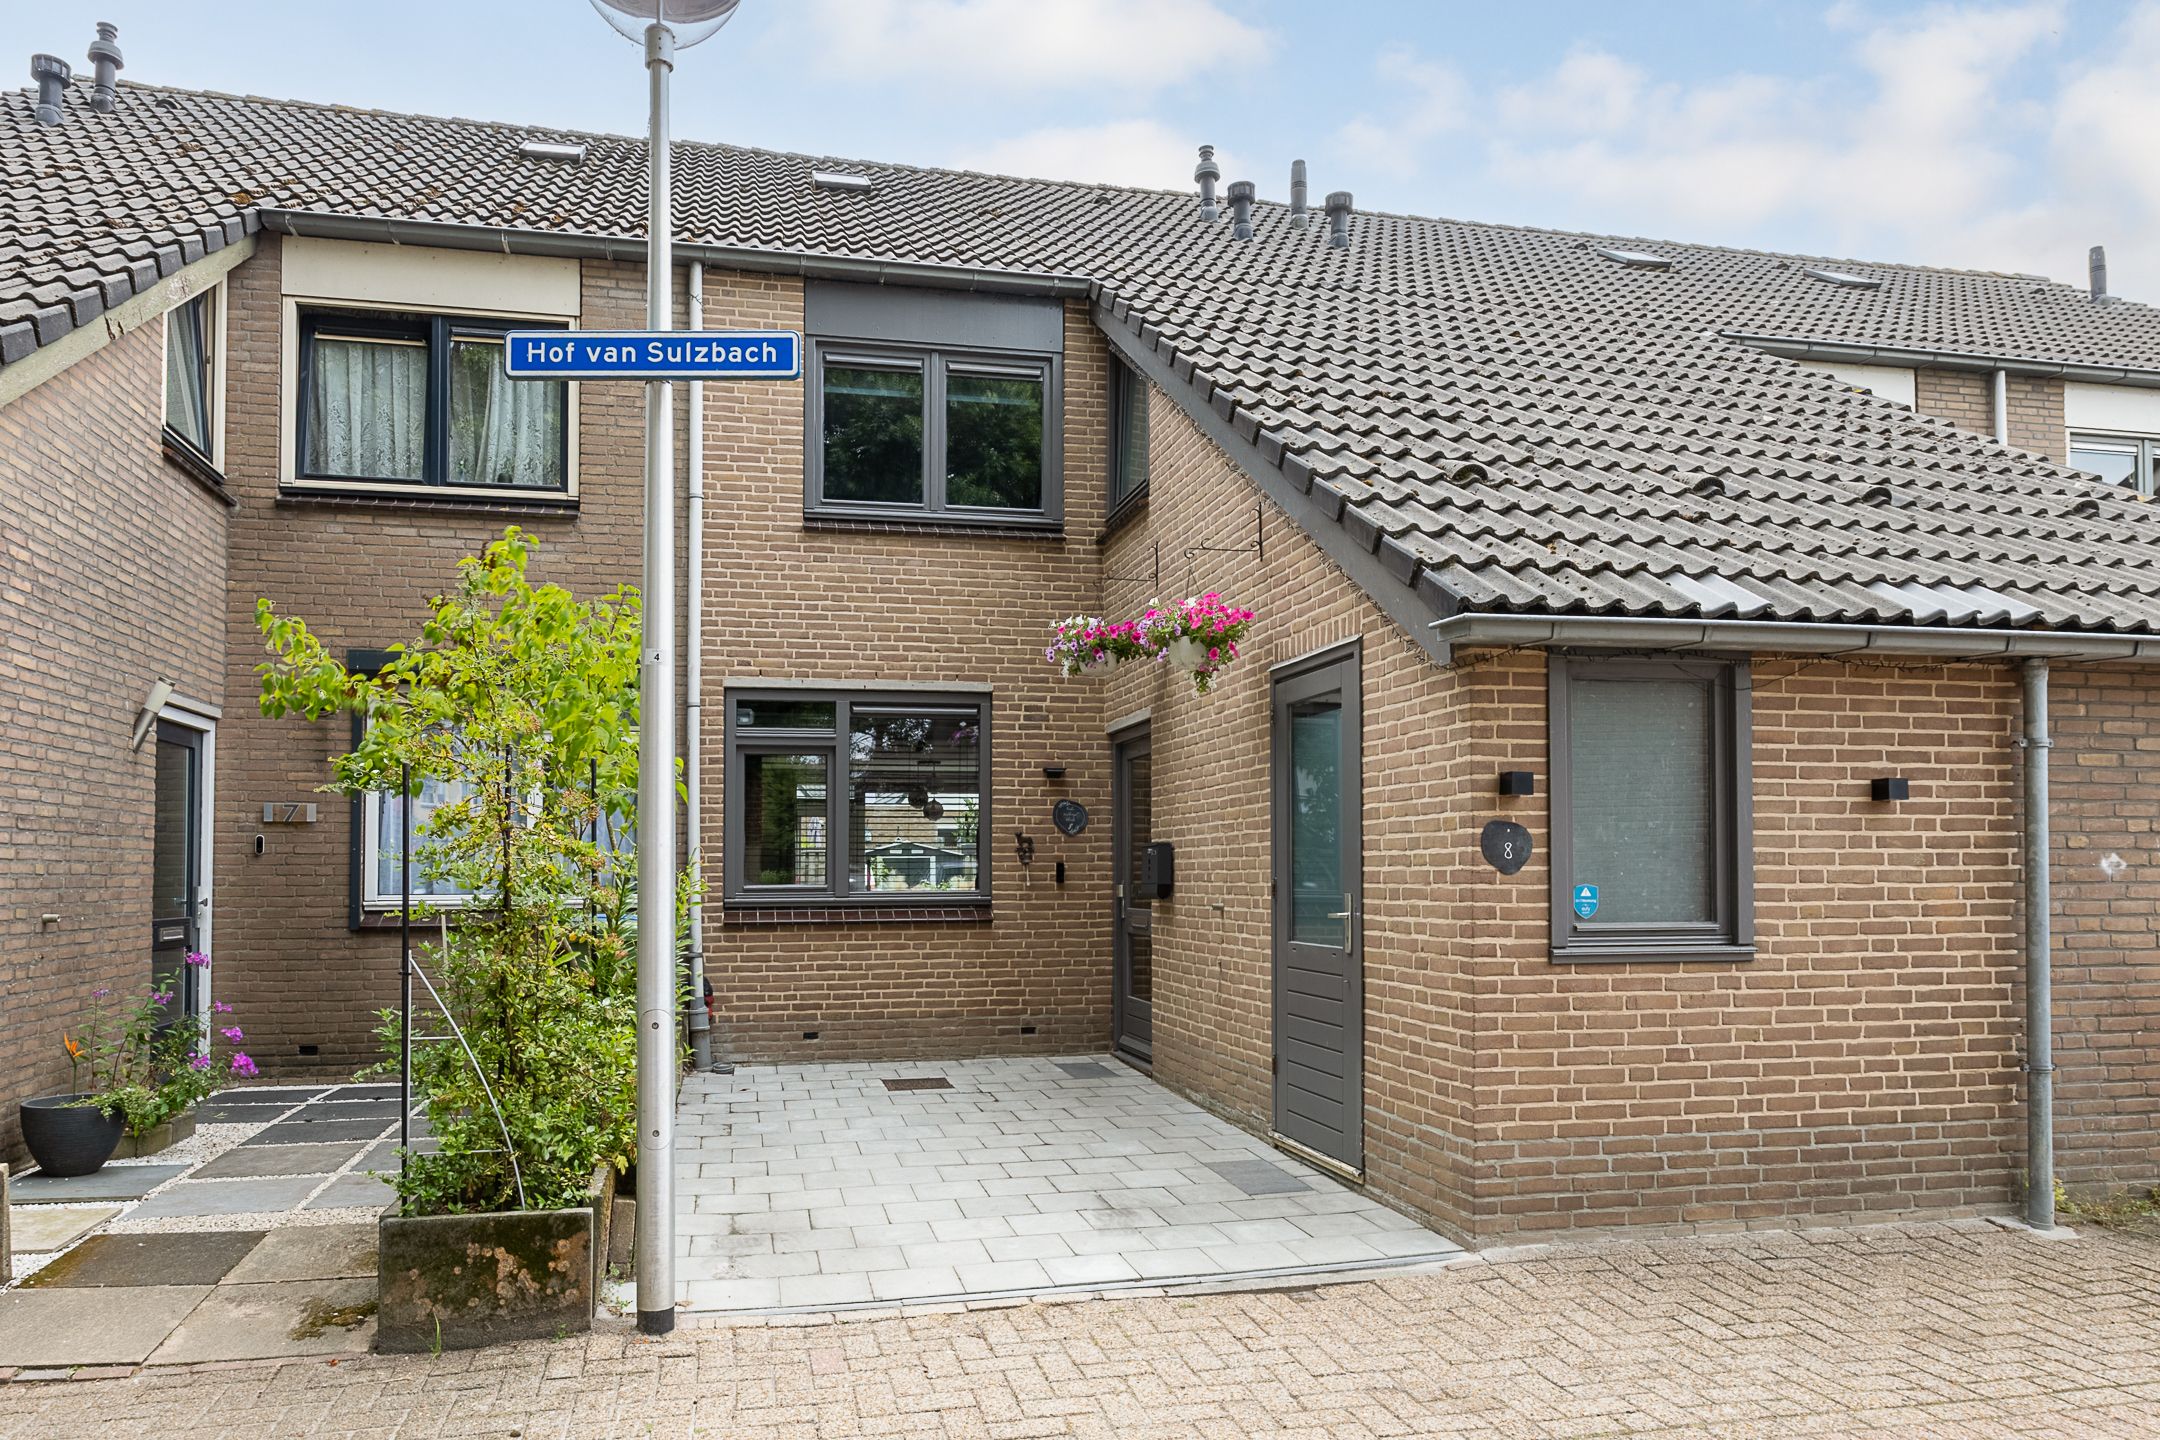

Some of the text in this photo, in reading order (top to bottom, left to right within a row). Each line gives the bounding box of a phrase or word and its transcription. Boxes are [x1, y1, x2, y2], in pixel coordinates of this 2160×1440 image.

[527, 341, 777, 363] Hof van Sulzbach
[653, 652, 660, 661] 4
[282, 803, 300, 824] 7
[1504, 841, 1513, 859] 8
